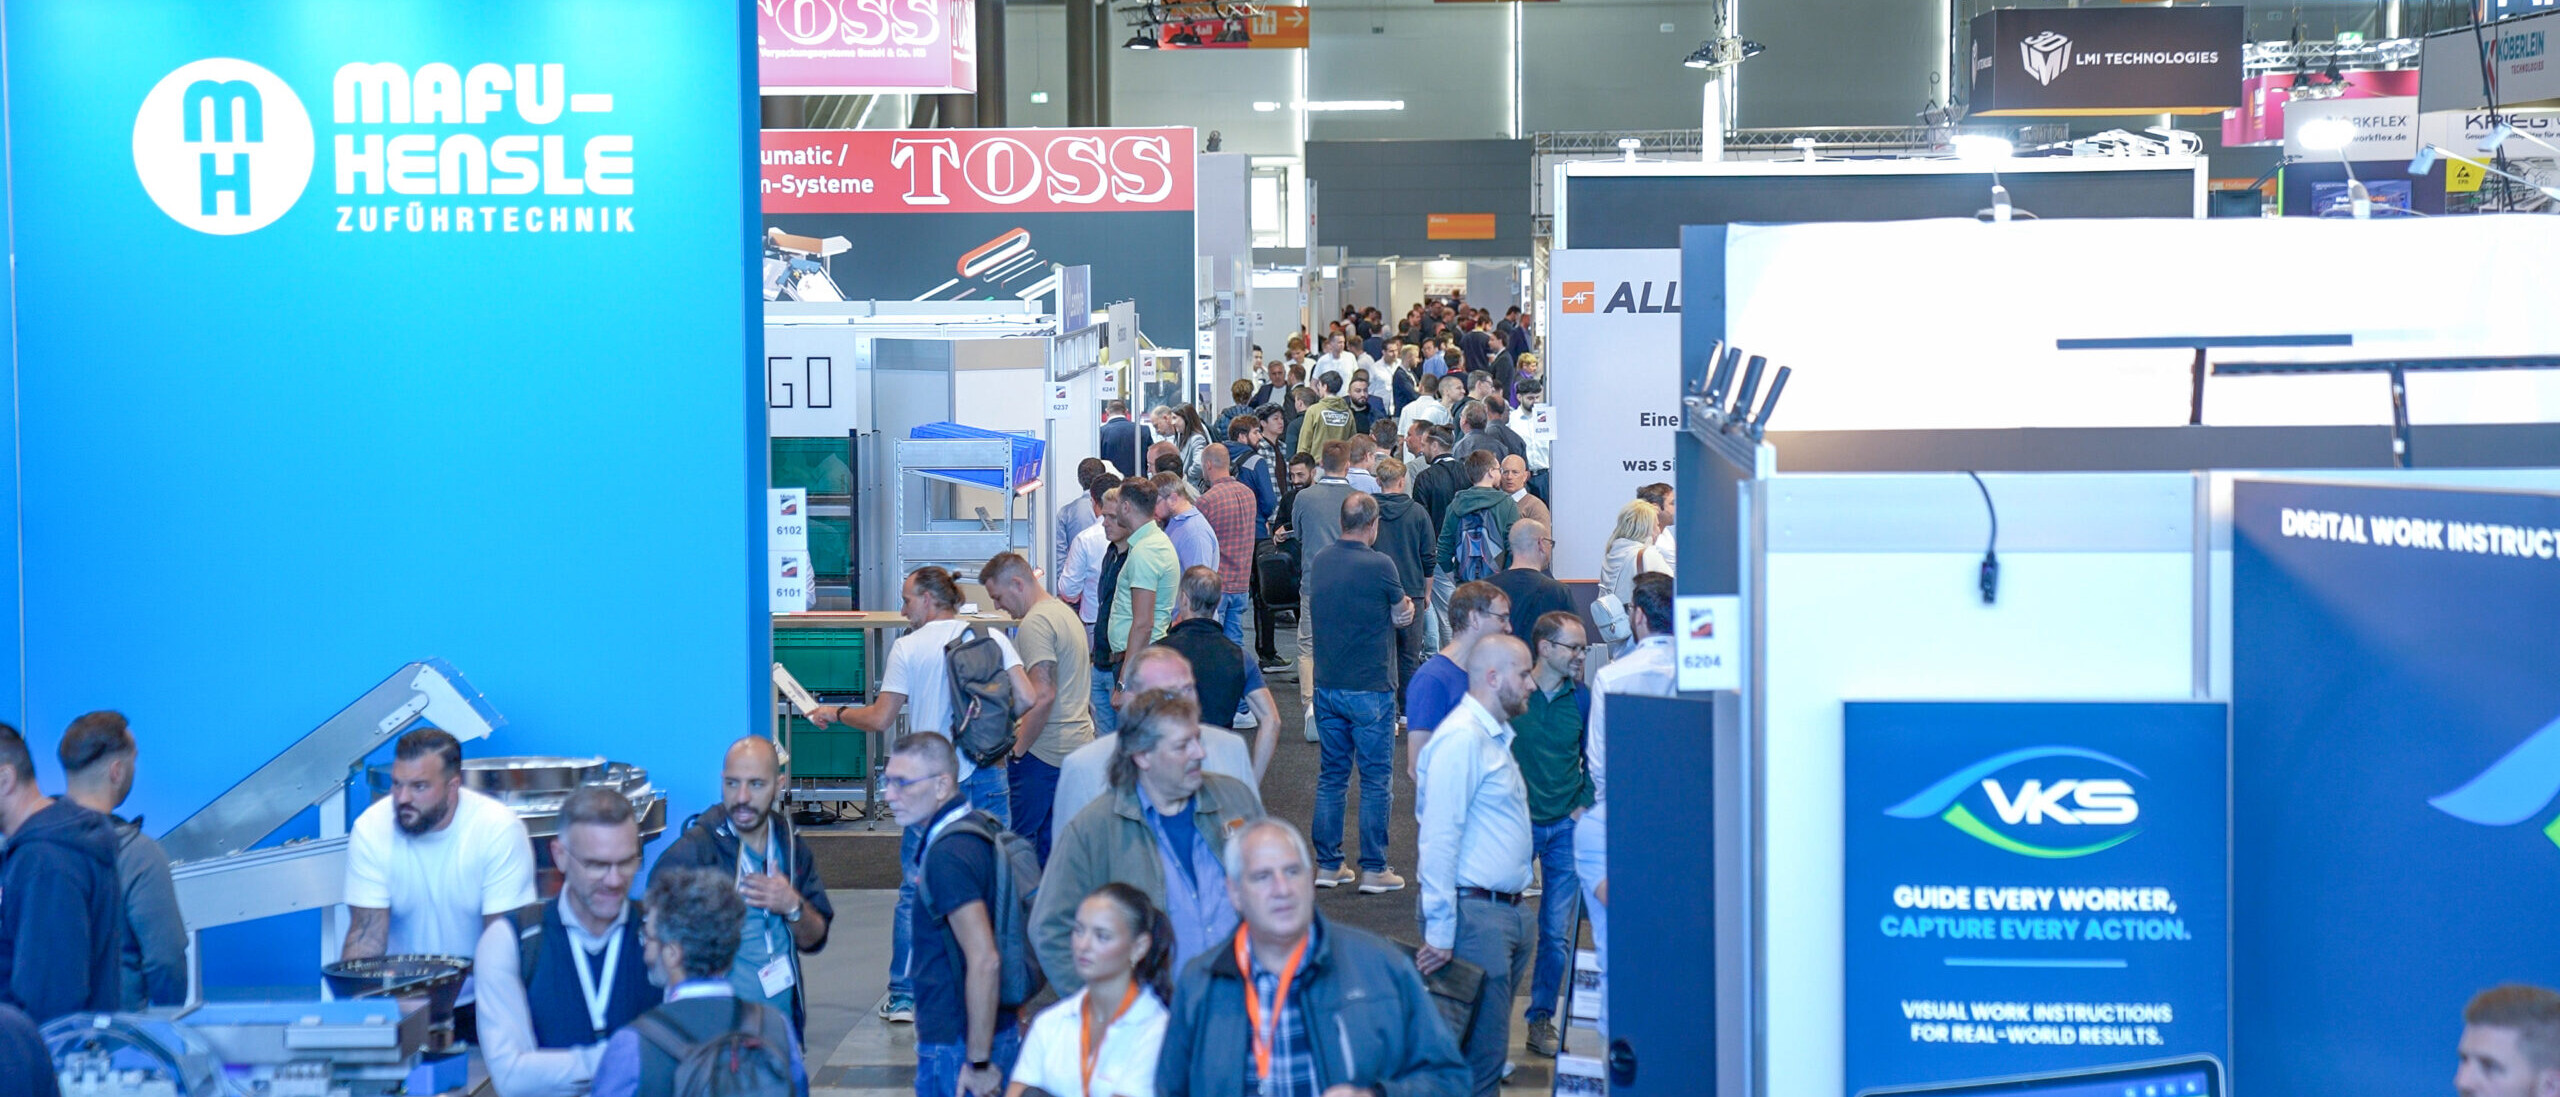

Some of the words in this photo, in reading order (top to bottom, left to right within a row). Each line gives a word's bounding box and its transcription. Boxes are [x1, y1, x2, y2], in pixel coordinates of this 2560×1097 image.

[759, 0, 940, 45] OSS
[2076, 53, 2100, 66] LMI
[2105, 52, 2219, 65] TECHNOLOGIES
[334, 62, 613, 124] MAFU-
[2340, 114, 2409, 128] RKFLEX
[335, 133, 634, 195] HENSLE
[760, 146, 833, 165] umatic
[891, 136, 1173, 204] TOSS
[760, 174, 874, 198] n-Systeme
[336, 201, 635, 232] ZUFÜHRTECHNIK
[1603, 281, 1681, 313] ALL
[1640, 412, 1679, 427] Eine
[1623, 460, 1657, 471] was
[777, 526, 802, 535] 6102
[2281, 508, 2368, 544] DIGITAL
[2370, 515, 2445, 550] WORK
[776, 588, 801, 597] 6101
[1684, 655, 1721, 669] 6204
[1981, 779, 2139, 824] VKS
[1893, 885, 1971, 909] GUIDE
[1975, 887, 2054, 911] EVERY
[2058, 887, 2177, 914] WORKER,
[1880, 914, 1996, 938] CAPTURE
[2000, 918, 2080, 940] EVERY
[2084, 919, 2191, 940] ACTION.
[1901, 1000, 1969, 1021] VISUAL
[1971, 1001, 2031, 1022] WORK
[2033, 1003, 2173, 1023] INSTRUCTIONS
[1911, 1023, 1949, 1042] FOR
[1951, 1024, 2076, 1045] REAL-WORLD
[2079, 1026, 2164, 1045] RESULTS.
